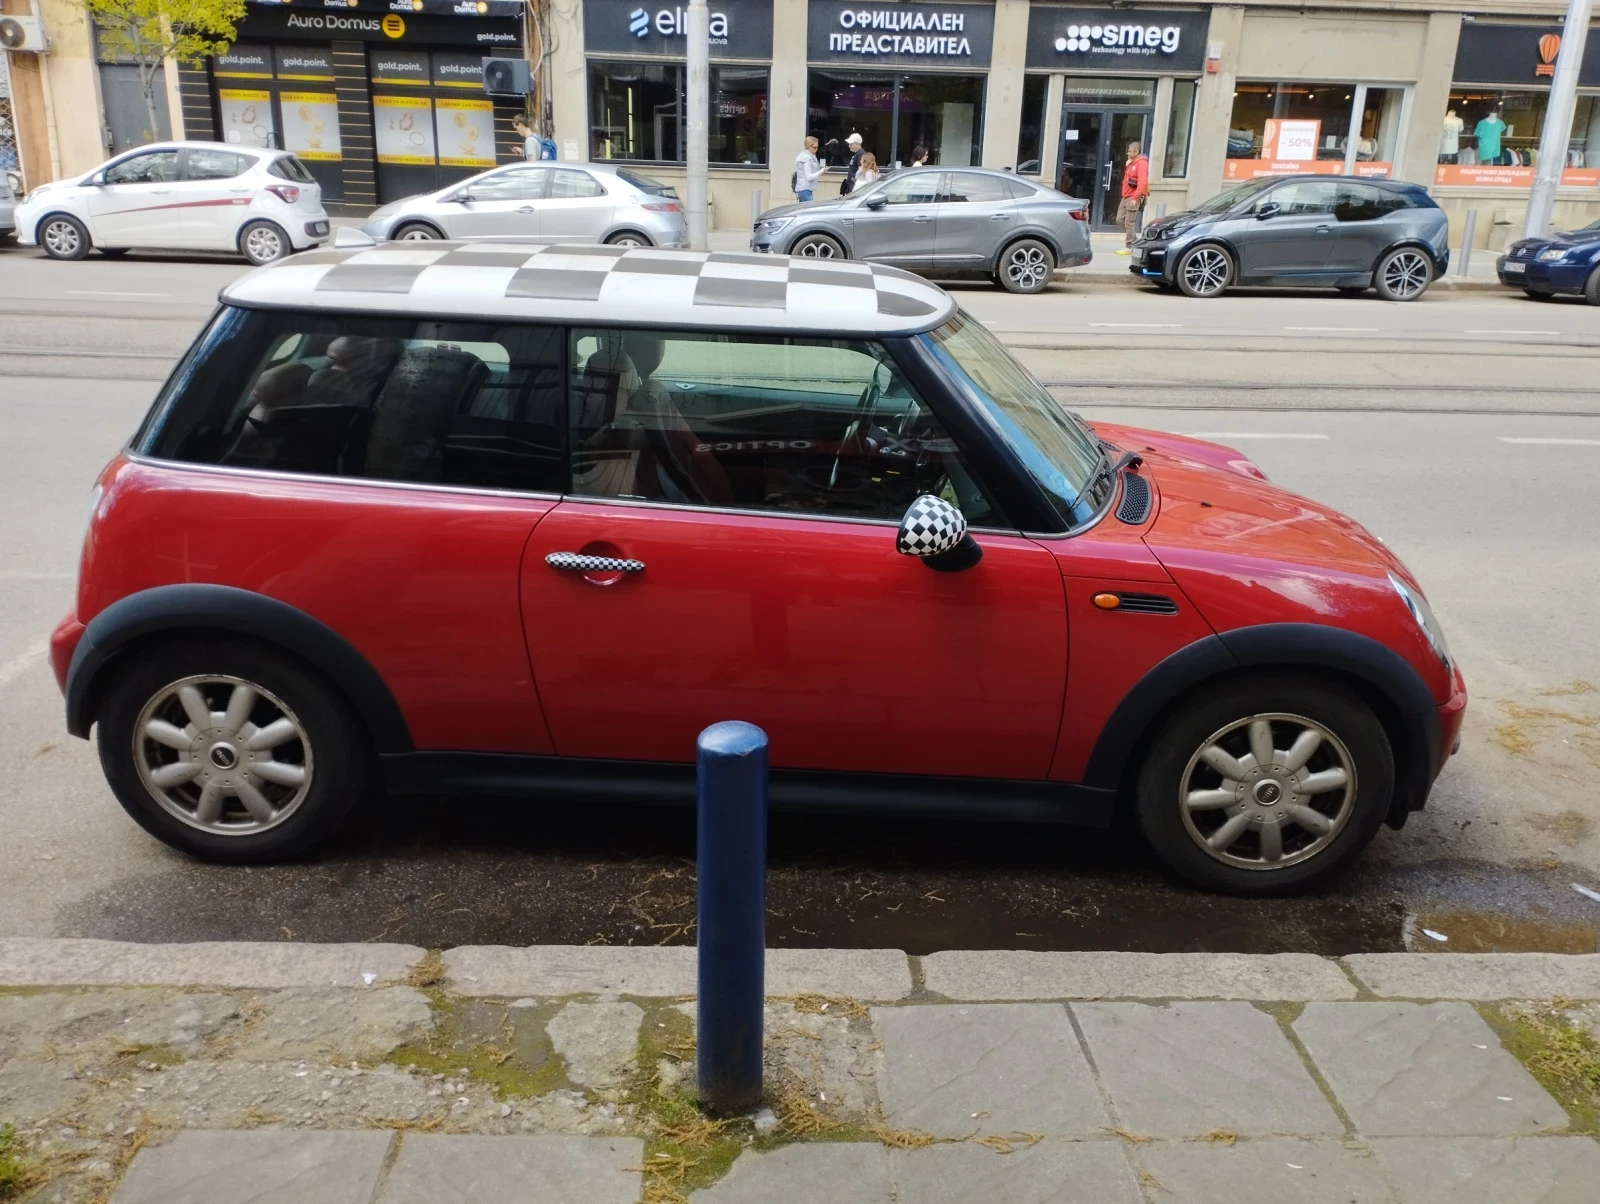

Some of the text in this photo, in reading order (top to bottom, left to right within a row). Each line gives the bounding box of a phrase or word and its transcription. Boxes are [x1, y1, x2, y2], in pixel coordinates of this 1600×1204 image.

[389, 2, 413, 10] Domus
[454, 5, 478, 13] Domus
[287, 13, 381, 30] Auro Domus
[655, 6, 728, 36] elia
[840, 10, 964, 31] ОФИЦИАЛЕН
[477, 33, 516, 41] gold.point.
[707, 37, 728, 45] uova
[1103, 25, 1180, 53] smeg
[829, 33, 971, 55] ПРЕДСТАВИТЕЛ
[1092, 46, 1125, 55] technology
[1141, 47, 1157, 55] style
[219, 55, 264, 64] gold.point.
[283, 58, 328, 67] gold.point.
[377, 62, 422, 71] gold.point.
[440, 64, 482, 74] gold.point
[1288, 138, 1312, 147] 50%
